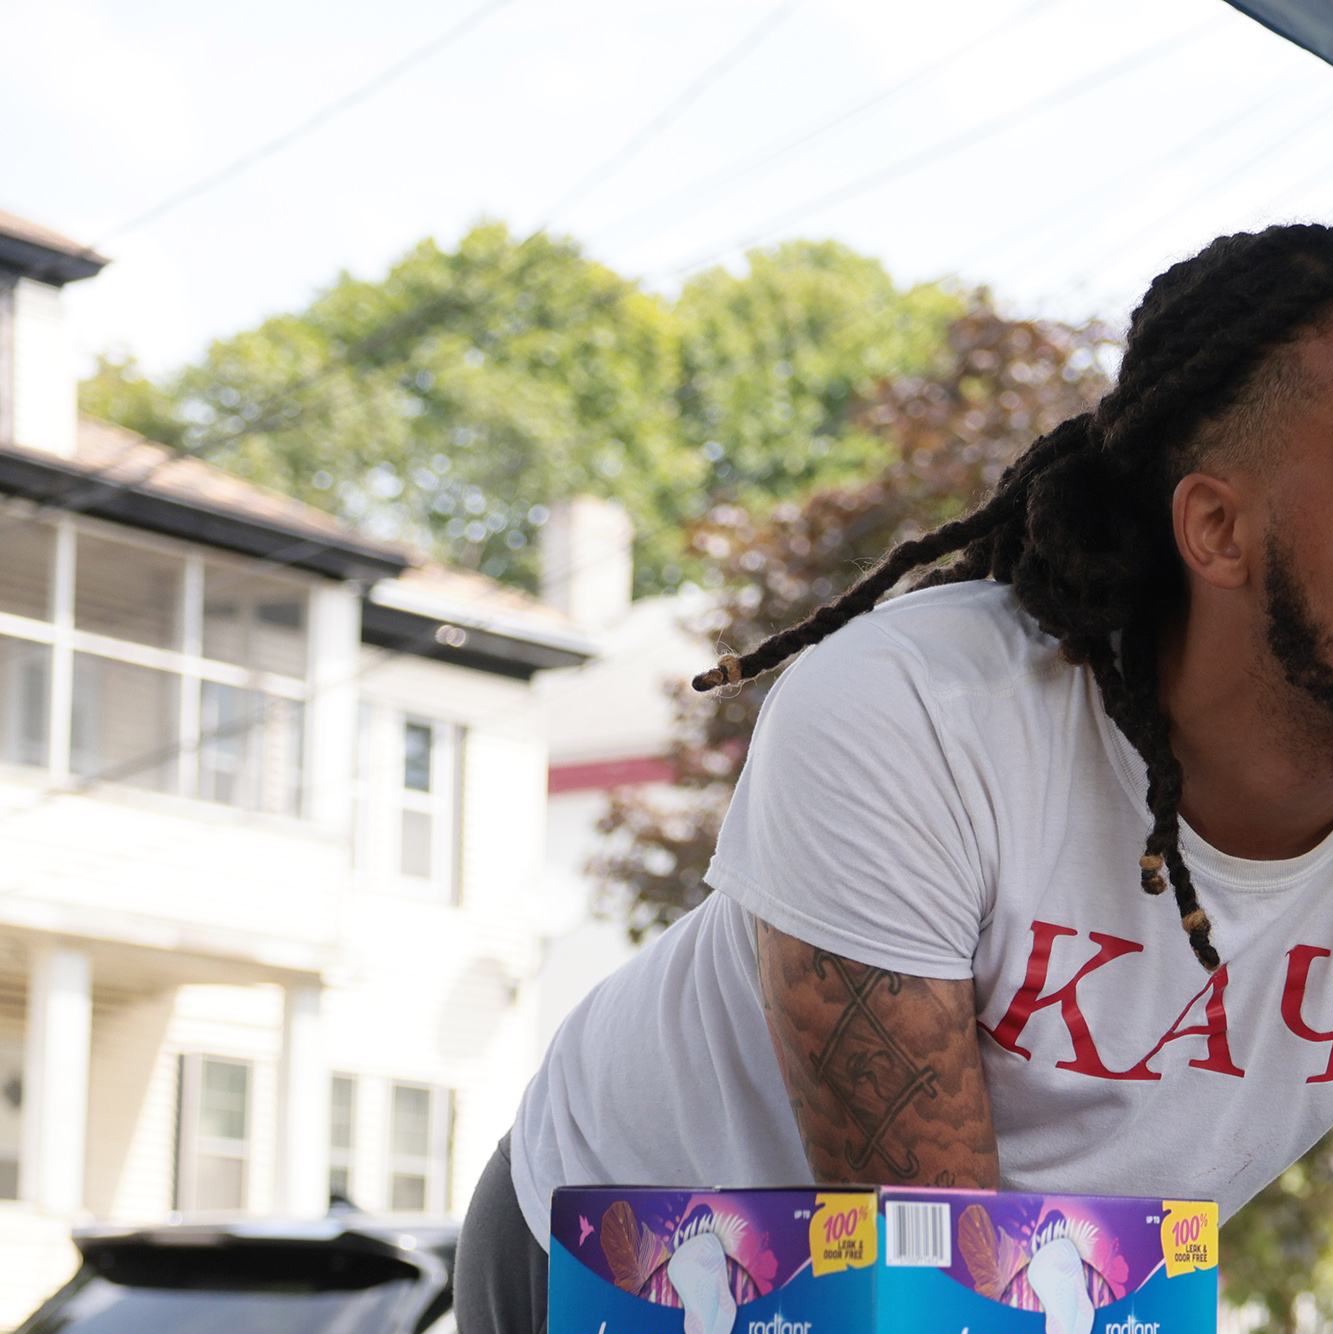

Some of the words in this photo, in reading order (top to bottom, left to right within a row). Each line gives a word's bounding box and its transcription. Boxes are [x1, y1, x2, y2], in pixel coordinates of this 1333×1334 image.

[823, 1206, 868, 1243] 100%
[1172, 1213, 1208, 1247] 100%
[838, 1240, 857, 1252] LEAK
[1185, 1244, 1200, 1254] LEAK
[823, 1250, 842, 1261] ODOR
[844, 1249, 864, 1261] FREE
[1174, 1253, 1190, 1263] ODOR
[1191, 1253, 1208, 1263] FREE
